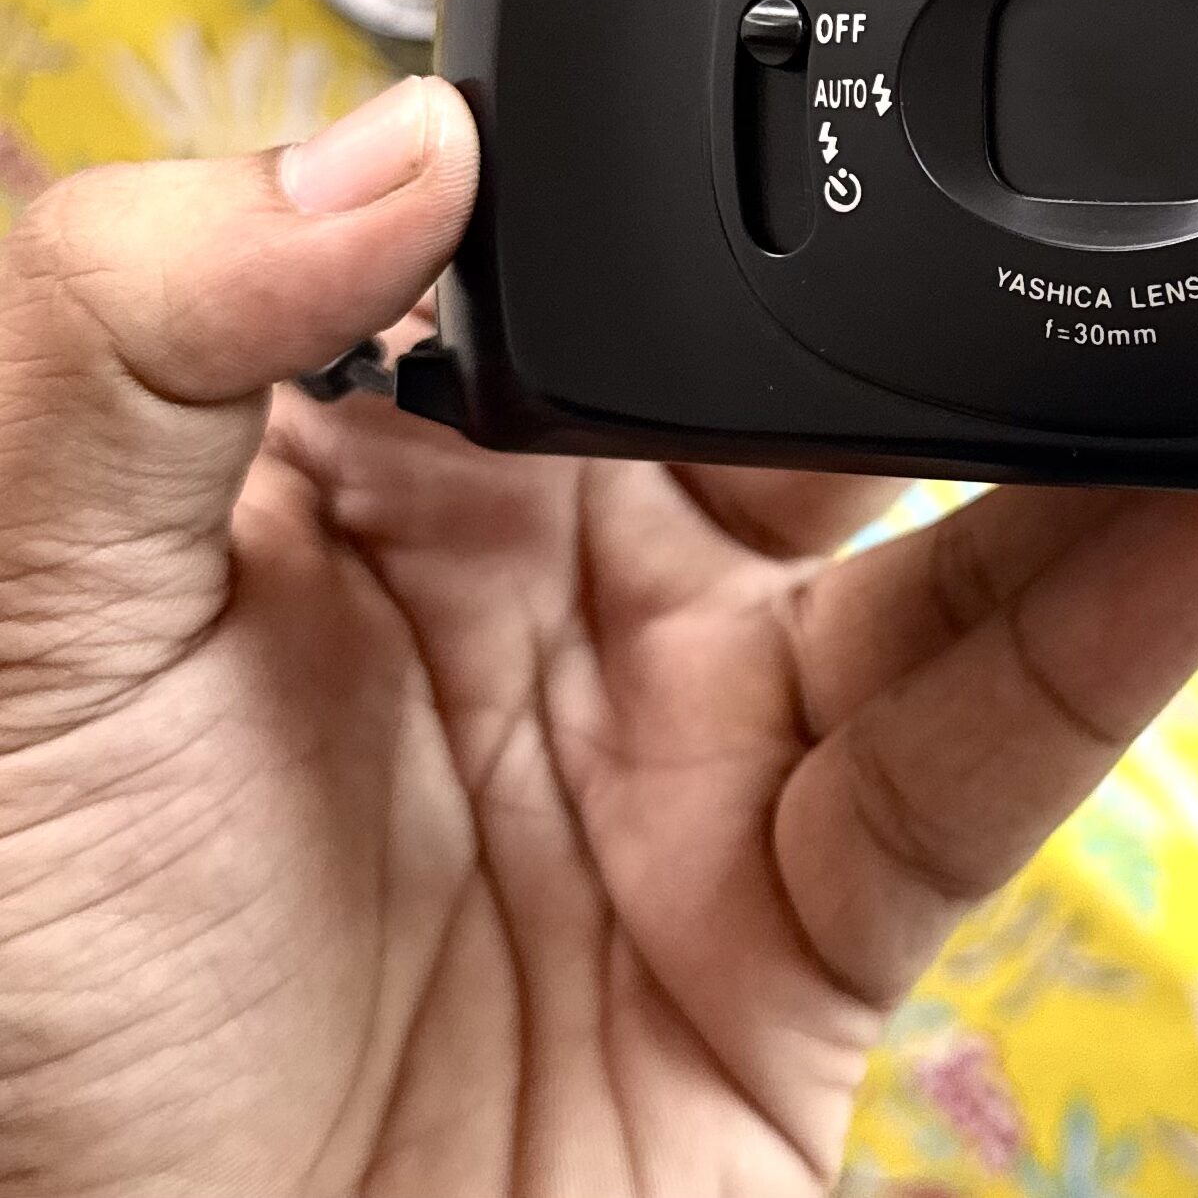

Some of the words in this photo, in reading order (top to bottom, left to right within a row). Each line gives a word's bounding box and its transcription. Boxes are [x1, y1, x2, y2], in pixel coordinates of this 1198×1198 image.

[815, 13, 867, 44] OFF
[814, 78, 867, 109] AUTO
[997, 266, 1113, 310] YASHICA
[1045, 318, 1158, 346] f=30mm
